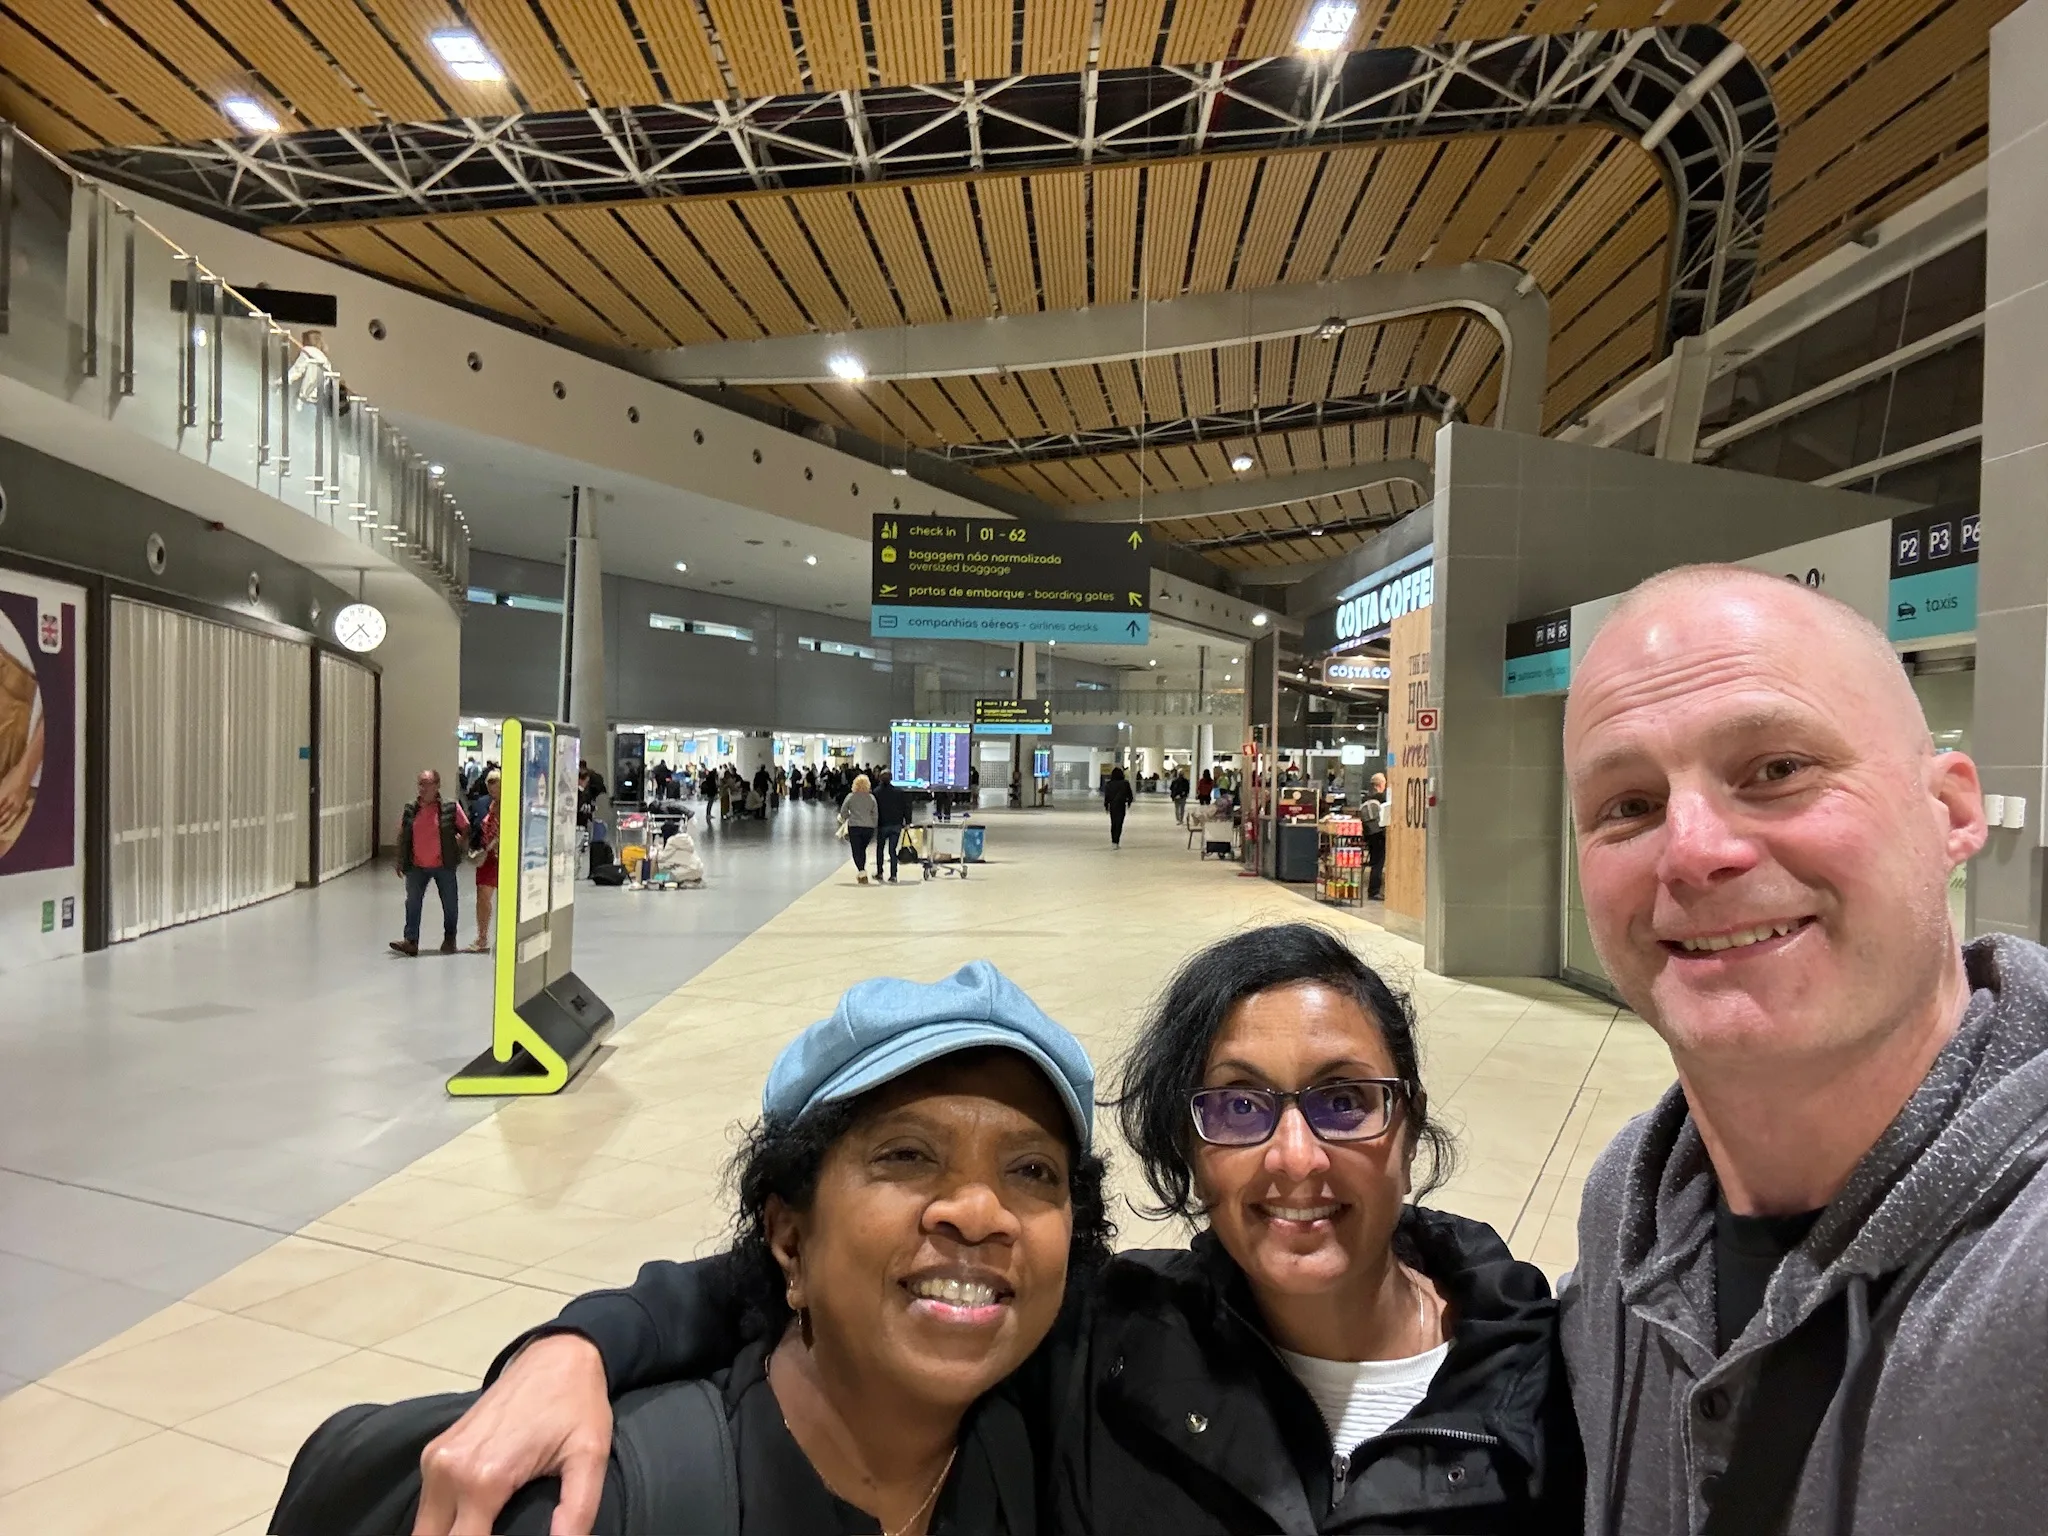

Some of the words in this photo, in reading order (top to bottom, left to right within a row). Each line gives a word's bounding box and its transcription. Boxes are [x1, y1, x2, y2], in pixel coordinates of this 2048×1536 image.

[909, 525, 943, 537] check
[946, 526, 957, 537] in
[979, 527, 994, 541] 01
[1008, 529, 1027, 542] 62
[1900, 537, 1918, 559] P2
[1929, 529, 1950, 553] P3
[908, 549, 965, 562] bagagem
[967, 551, 989, 562] não
[991, 553, 1062, 565] normalizada
[909, 562, 960, 572] oversized
[962, 563, 1011, 577] baggage
[908, 586, 947, 597] portas
[948, 585, 964, 597] de
[966, 586, 1025, 601] embarque
[1034, 589, 1083, 603] boarding
[1084, 590, 1115, 603] gates
[1925, 592, 1959, 613] taxis
[1336, 590, 1380, 640] COSTA
[908, 617, 979, 630] companhias
[981, 617, 1020, 629] aéreas
[1029, 620, 1066, 631] airlines
[1068, 621, 1099, 632] desks
[1328, 664, 1371, 679] COSTA
